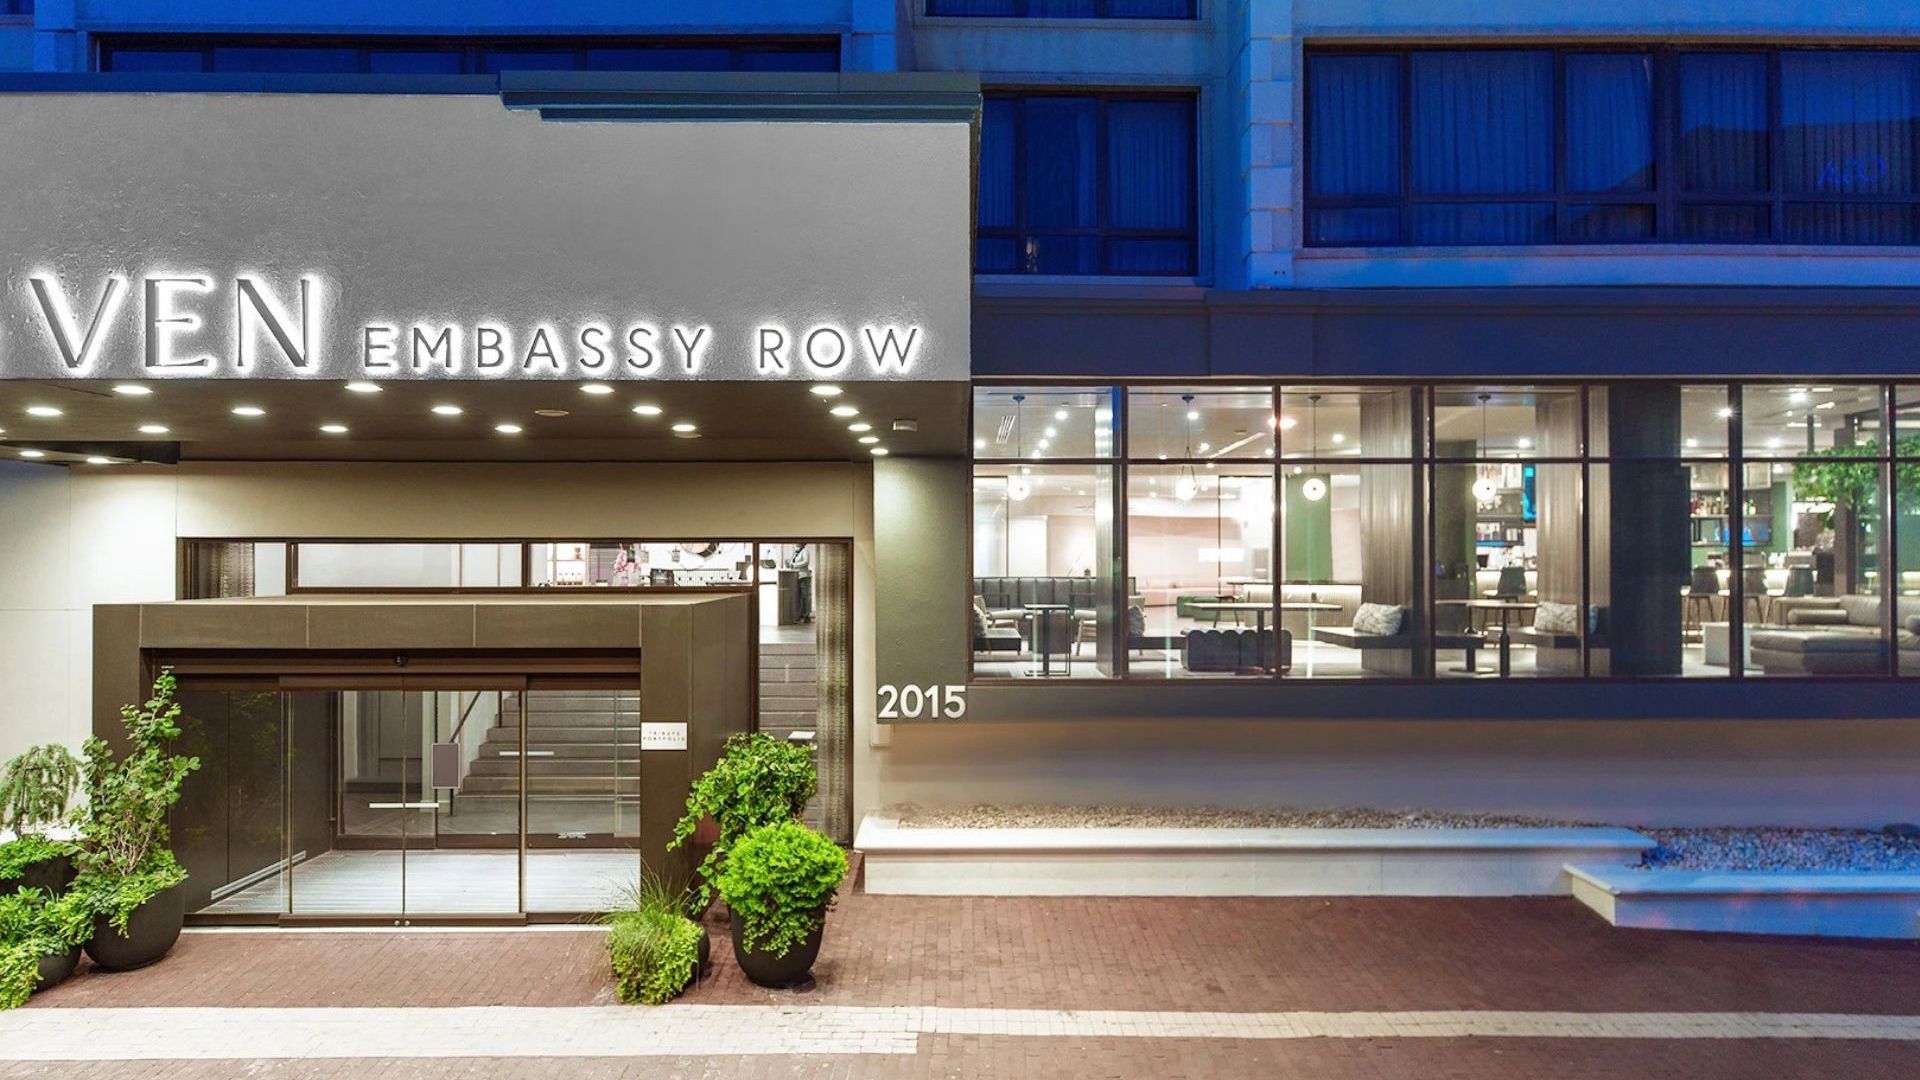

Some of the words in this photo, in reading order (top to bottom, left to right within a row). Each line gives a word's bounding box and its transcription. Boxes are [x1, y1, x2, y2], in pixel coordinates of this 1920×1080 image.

[29, 277, 311, 368] VEN
[363, 326, 706, 369] EMBASSY
[758, 326, 918, 369] ROW
[877, 684, 966, 719] 2015
